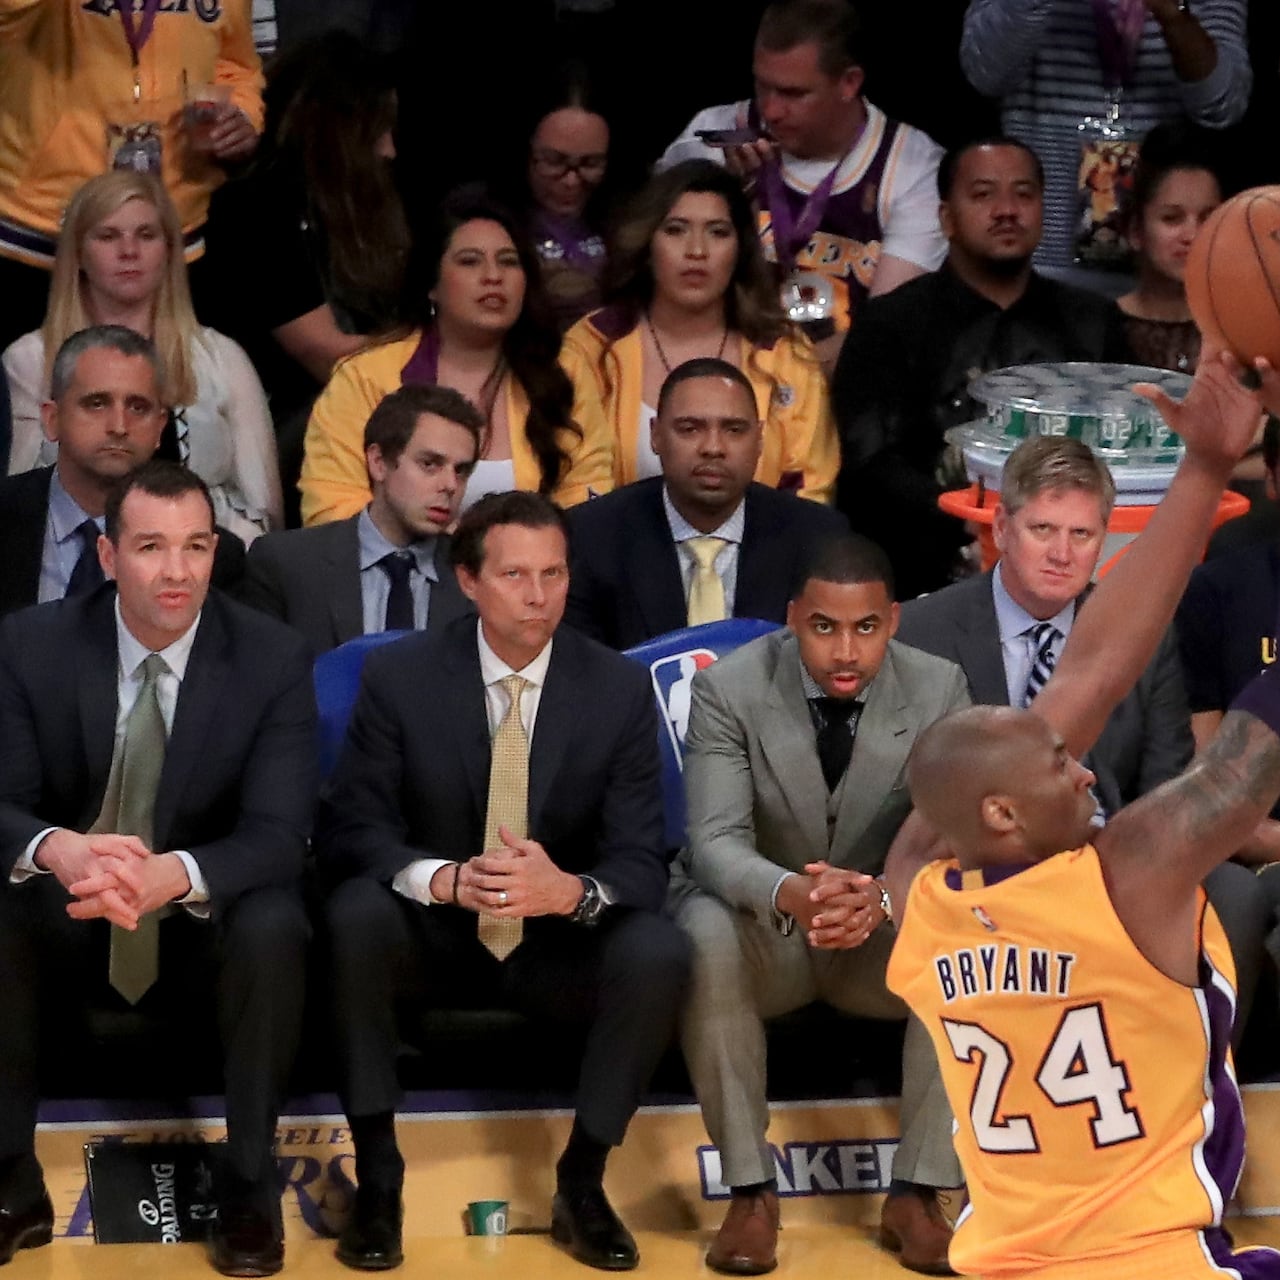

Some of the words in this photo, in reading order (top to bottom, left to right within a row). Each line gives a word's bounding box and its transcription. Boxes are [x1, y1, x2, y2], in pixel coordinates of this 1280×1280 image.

[1102, 417, 1132, 440] 02
[934, 943, 1076, 1003] BRYANT
[938, 1001, 1147, 1154] 24
